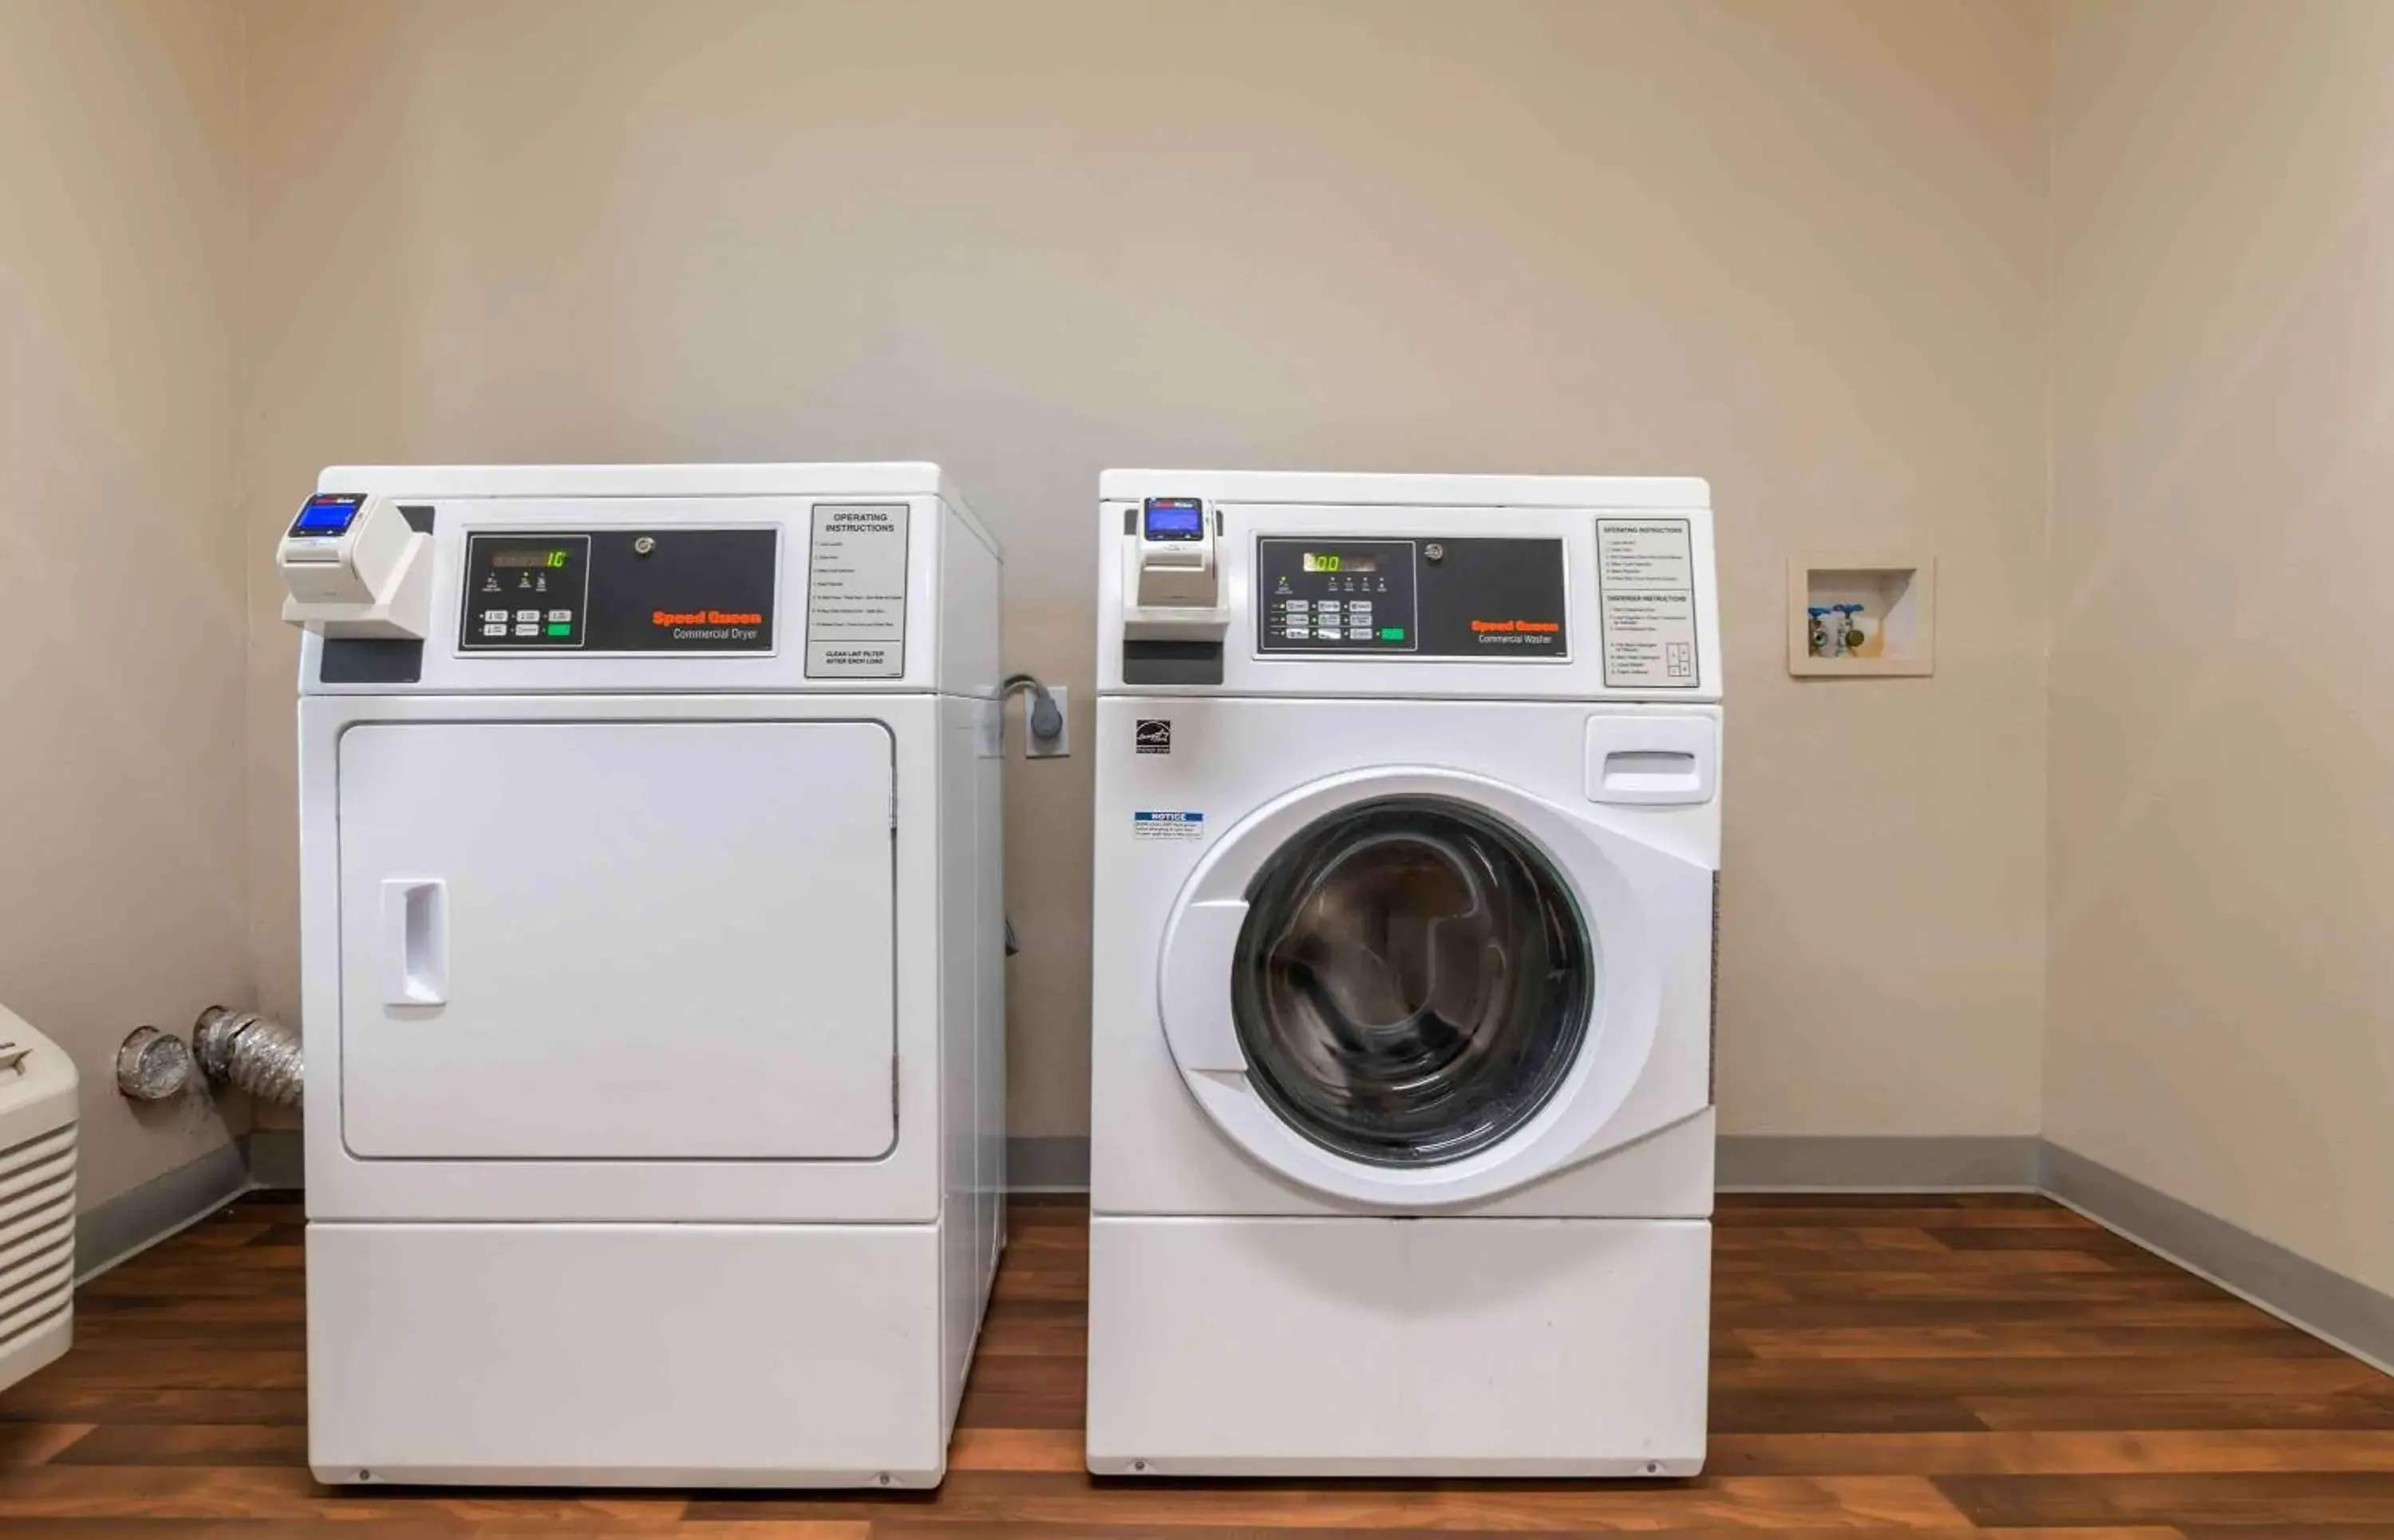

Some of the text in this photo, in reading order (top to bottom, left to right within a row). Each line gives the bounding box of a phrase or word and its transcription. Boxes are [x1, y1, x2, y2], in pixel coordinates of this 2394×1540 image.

[652, 610, 762, 627] Speed Queen
[1471, 620, 1558, 633] Speed Queen
[673, 628, 758, 642] Commercial Dryer
[1479, 634, 1552, 644] Commercial Washer
